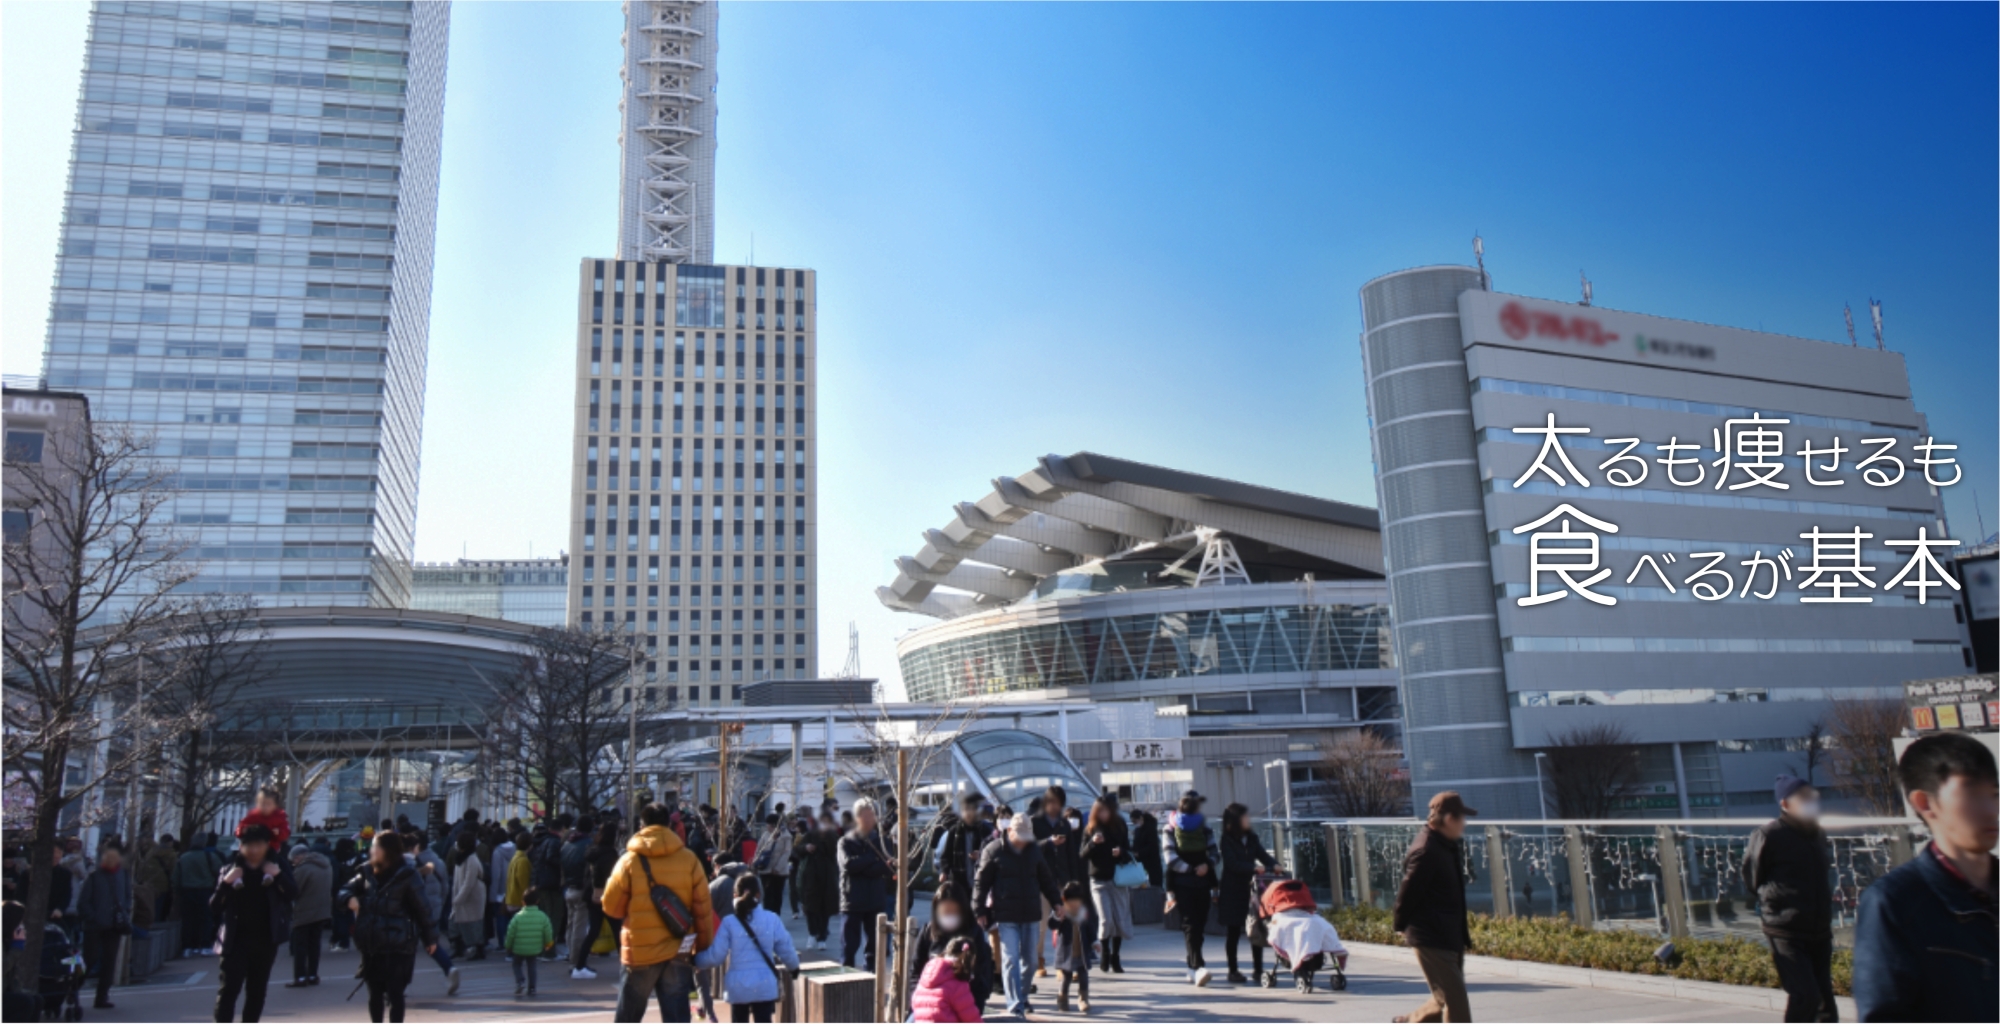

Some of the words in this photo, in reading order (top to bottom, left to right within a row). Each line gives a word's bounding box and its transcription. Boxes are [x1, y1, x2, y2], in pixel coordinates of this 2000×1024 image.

[1908, 685, 1935, 696] Park
[1936, 681, 1963, 694] Side
[1964, 679, 1997, 693] Bldg.
